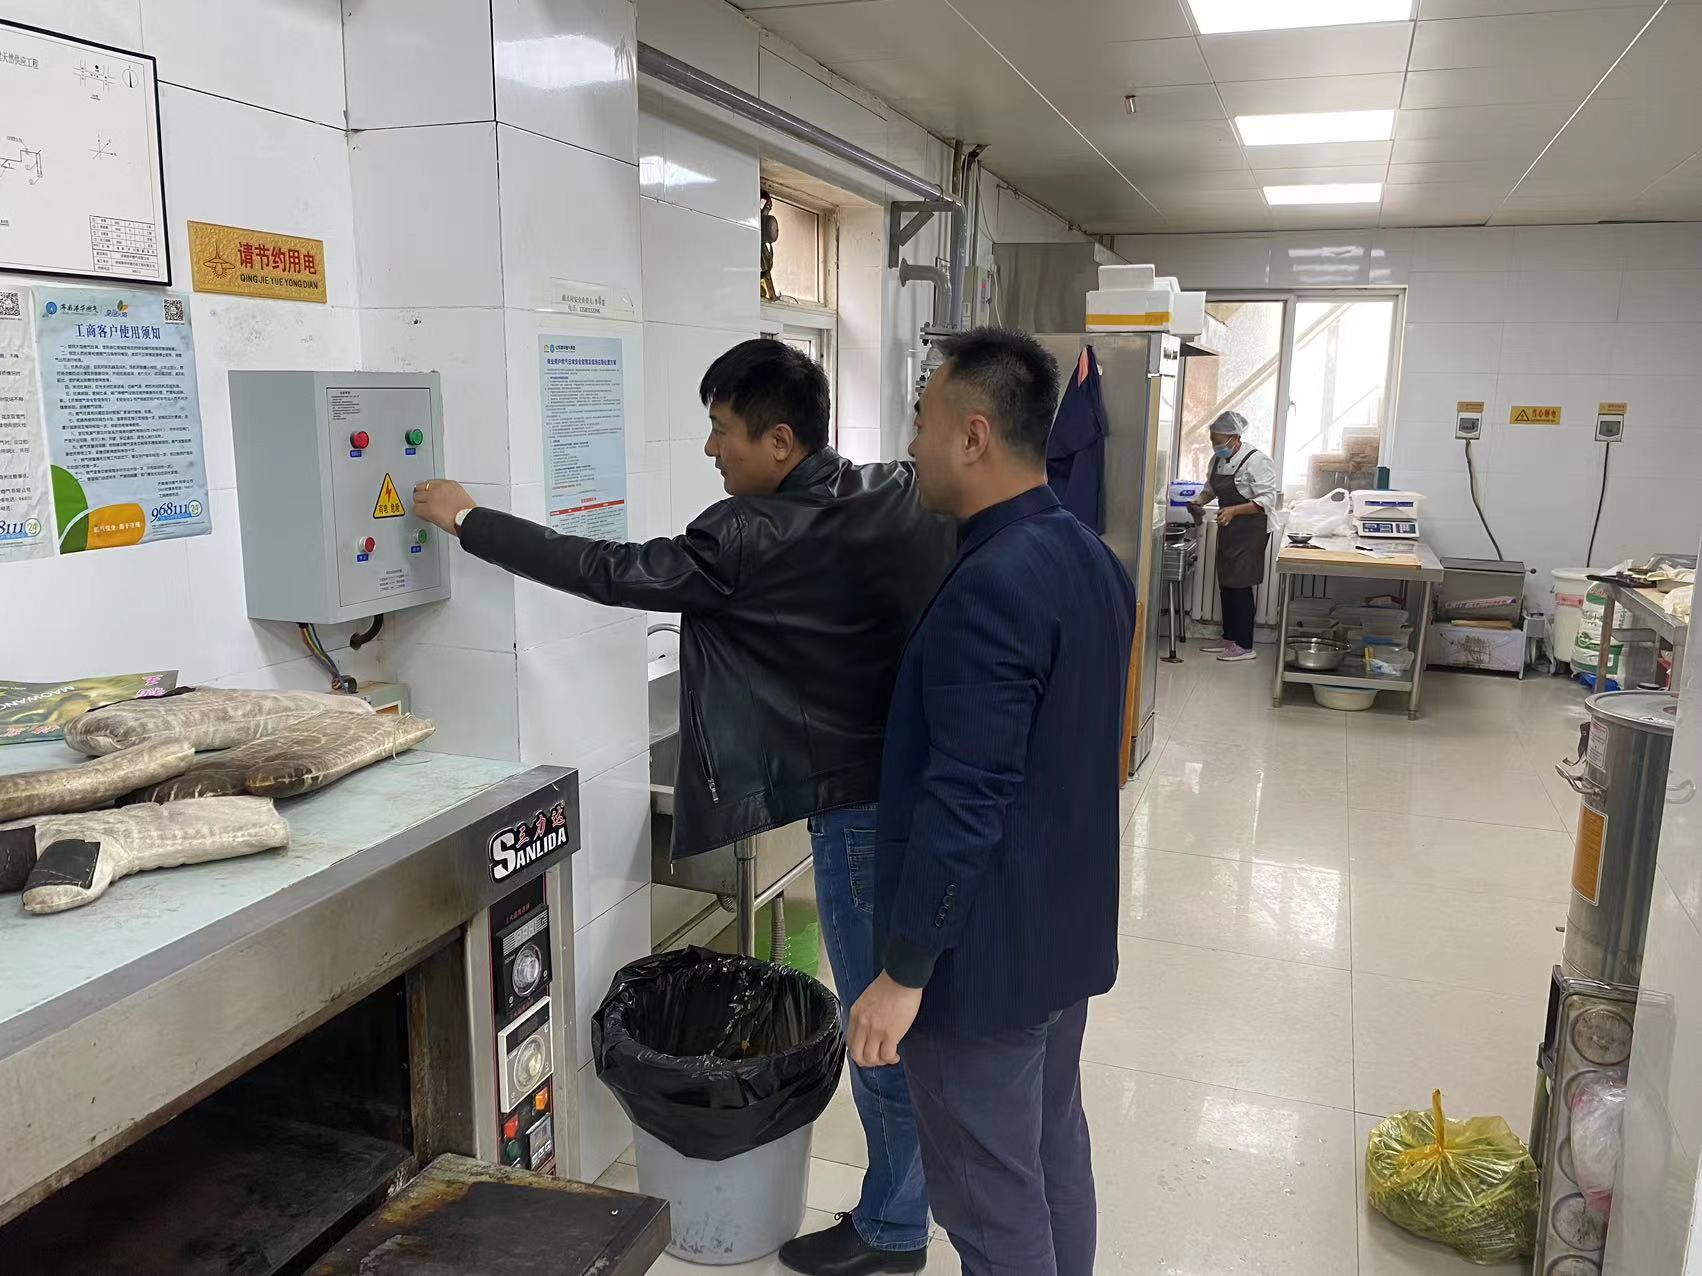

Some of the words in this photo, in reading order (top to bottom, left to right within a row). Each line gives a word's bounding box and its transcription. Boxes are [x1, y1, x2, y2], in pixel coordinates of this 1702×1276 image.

[238, 242, 317, 275] 请节约用电
[240, 273, 258, 284] QING
[260, 276, 269, 284] JIE
[271, 277, 284, 286] YUE
[284, 278, 302, 287] YONG
[303, 280, 318, 289] DIAN
[74, 323, 161, 340] 工商客户使用须知
[150, 502, 188, 523] 968111
[492, 826, 567, 880] SANLIDA
